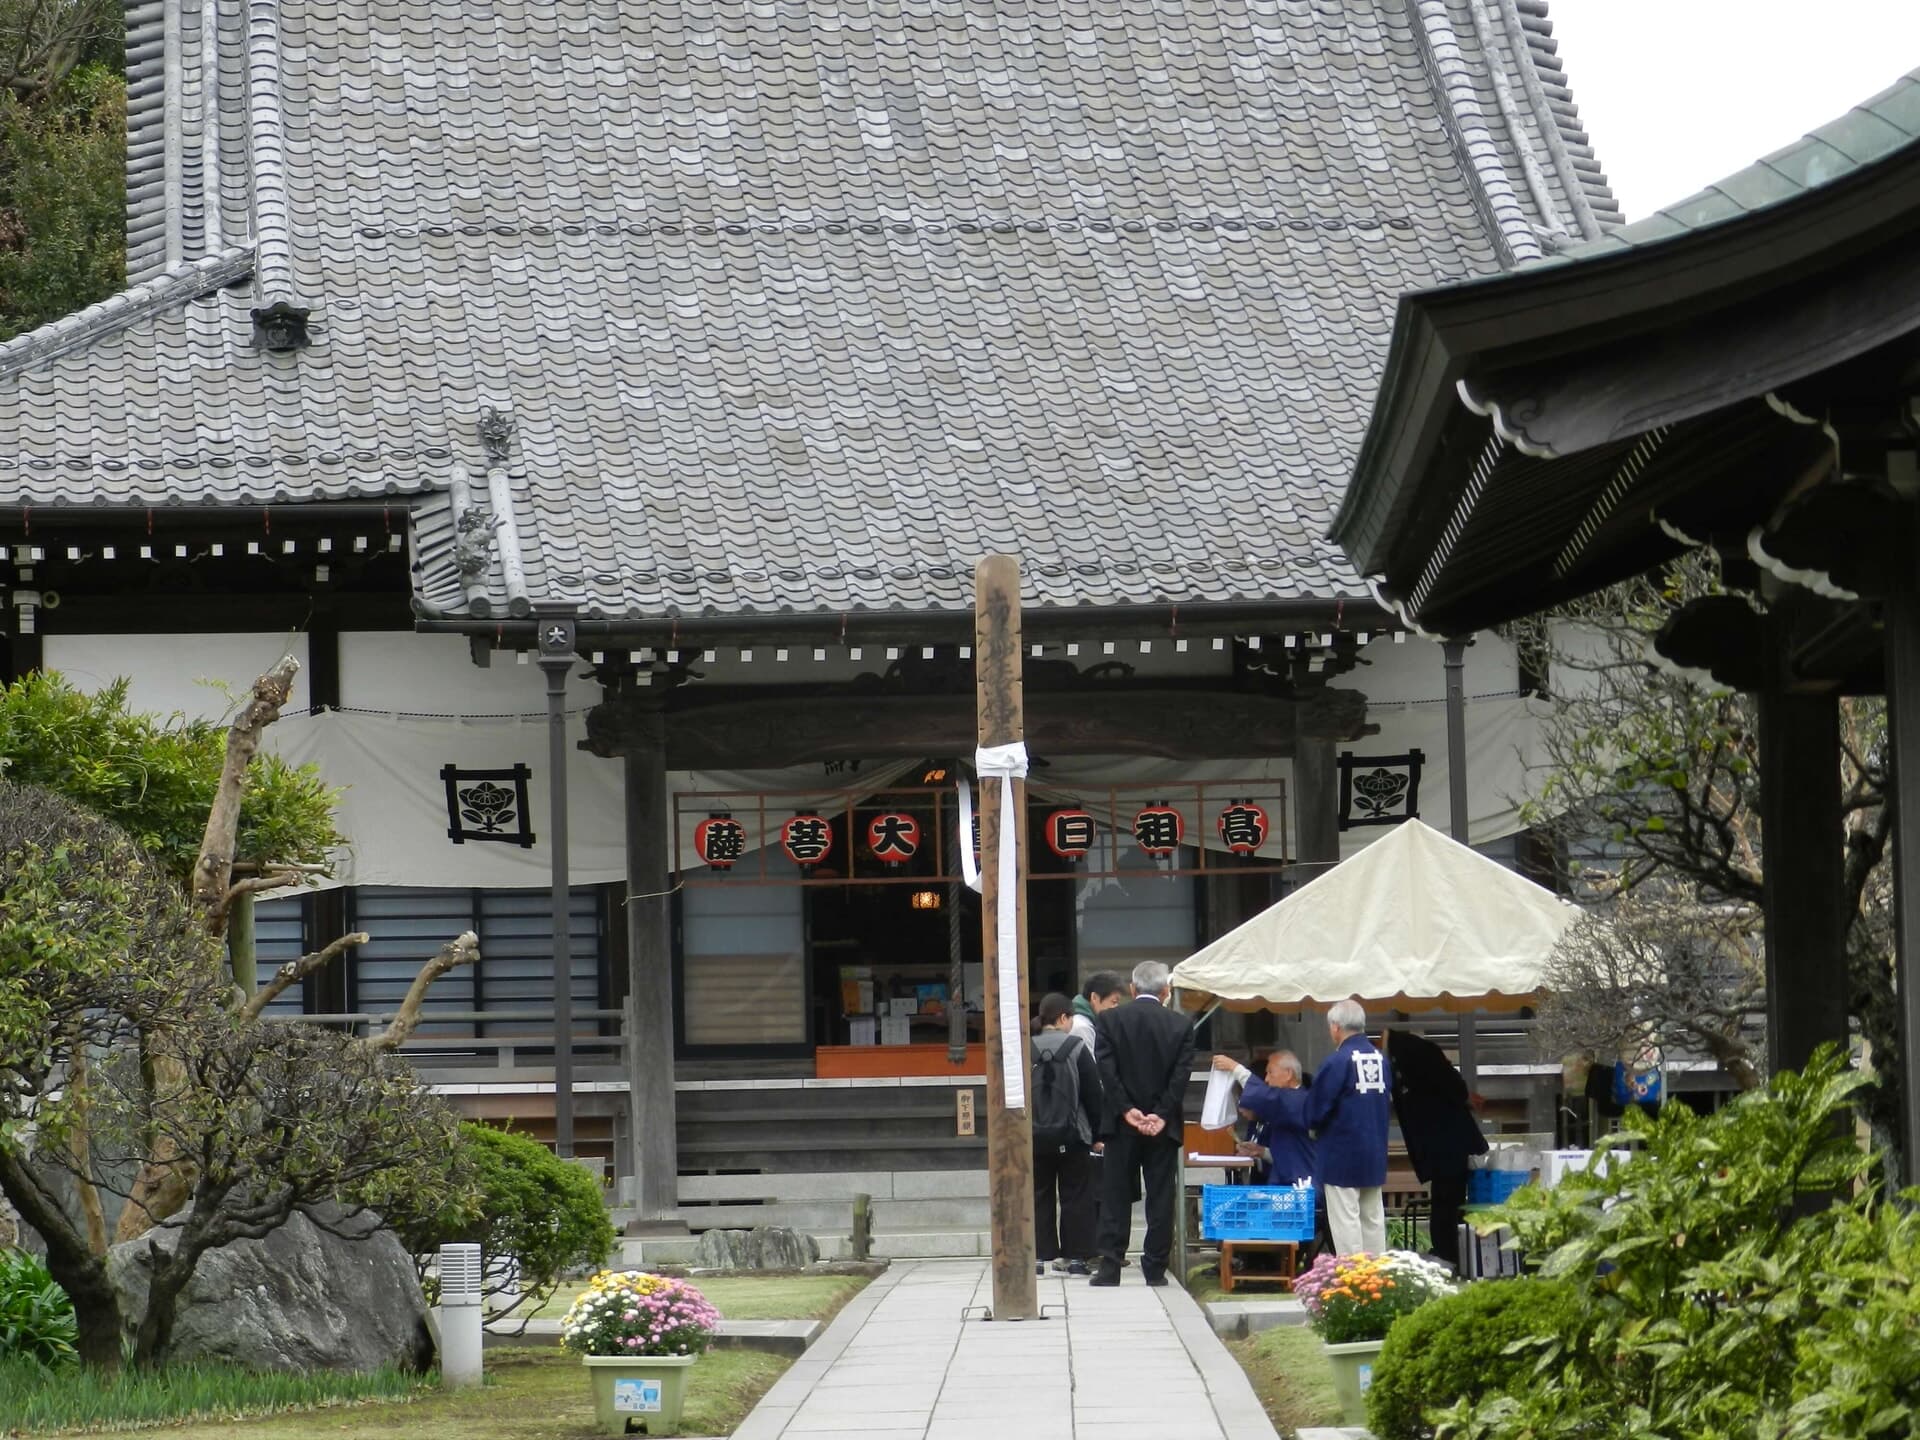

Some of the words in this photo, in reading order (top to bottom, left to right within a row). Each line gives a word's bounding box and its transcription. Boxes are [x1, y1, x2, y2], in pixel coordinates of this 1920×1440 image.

[871, 816, 916, 854] 大
[1056, 815, 1096, 851] 日
[1134, 811, 1180, 849] 祖
